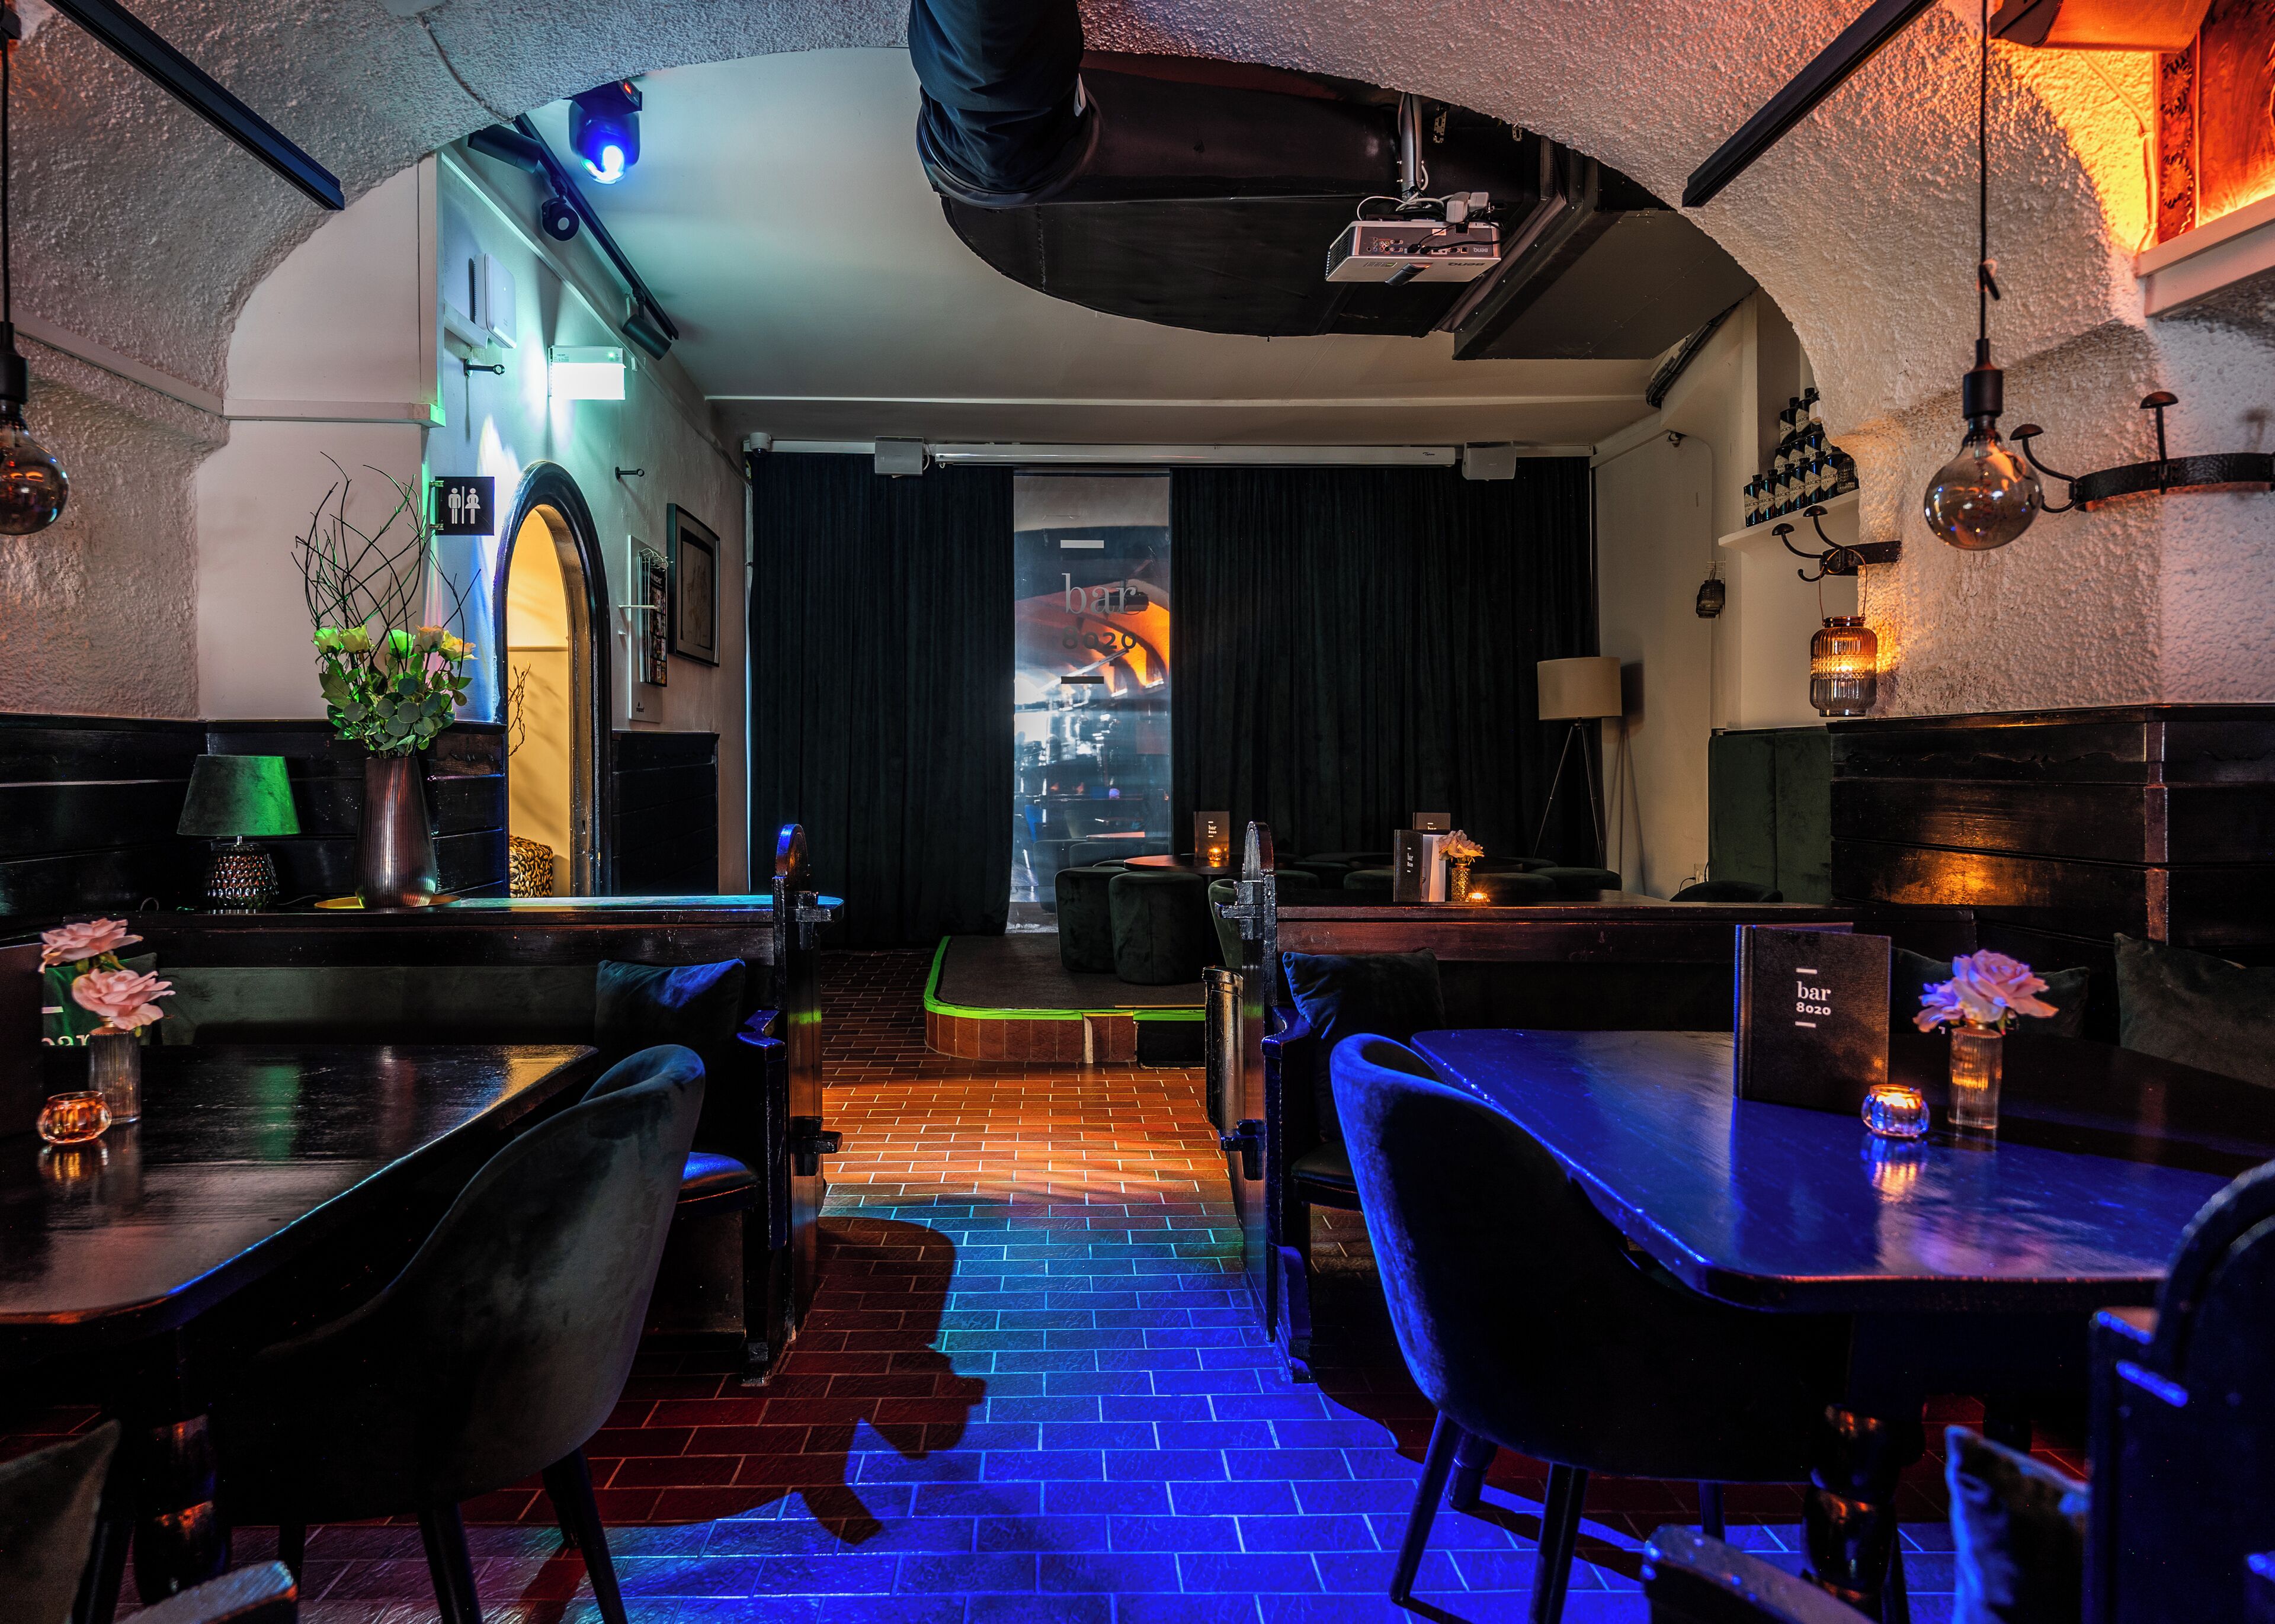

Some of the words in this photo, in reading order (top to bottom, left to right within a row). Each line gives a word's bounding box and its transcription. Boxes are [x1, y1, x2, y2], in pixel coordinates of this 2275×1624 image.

[1061, 573, 1137, 615] bar
[1062, 625, 1137, 650] 8020
[1796, 981, 1832, 1001] bar
[1796, 1002, 1832, 1016] 8020
